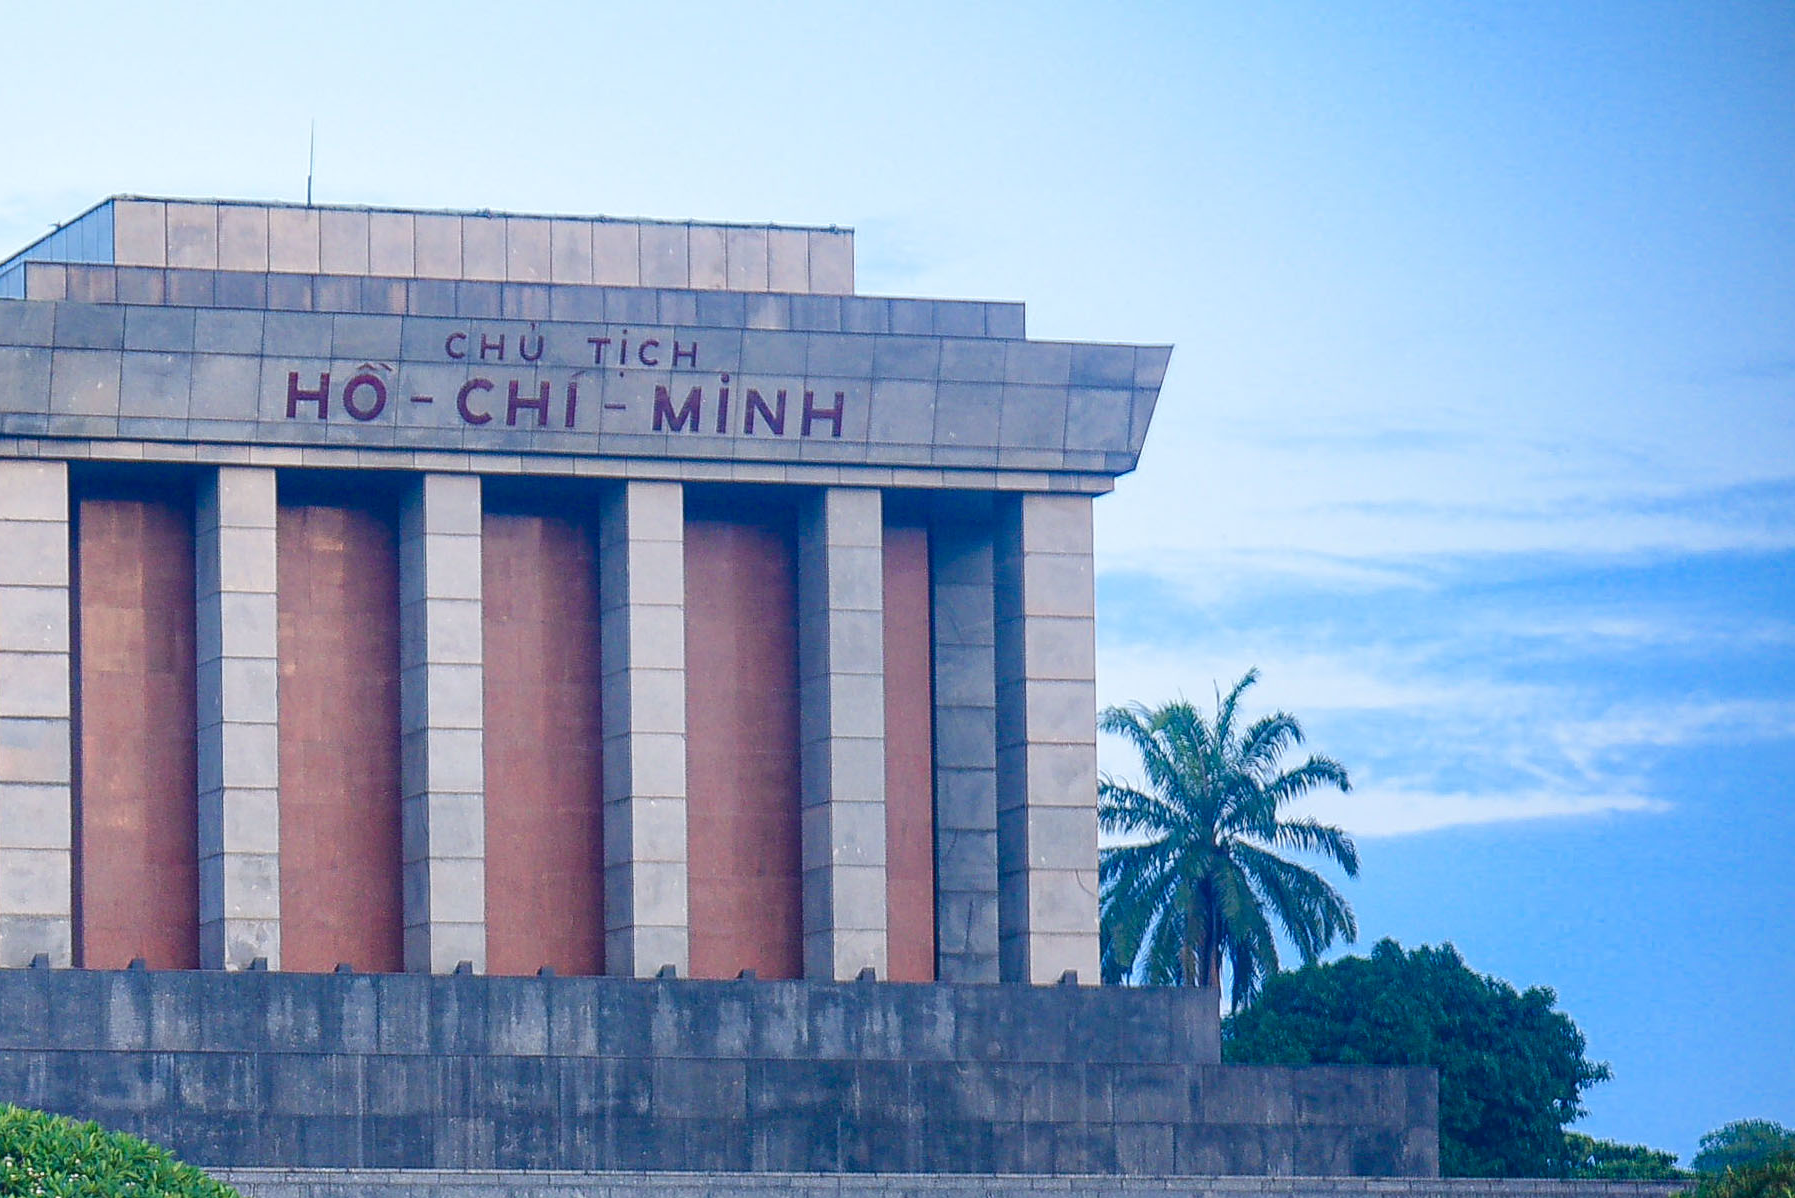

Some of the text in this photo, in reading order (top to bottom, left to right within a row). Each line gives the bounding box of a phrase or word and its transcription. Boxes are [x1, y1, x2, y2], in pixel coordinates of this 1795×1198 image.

[445, 322, 545, 361] CHỦ
[286, 363, 394, 421] HỒ
[456, 370, 586, 428] CHÍ
[652, 371, 845, 438] MINH
